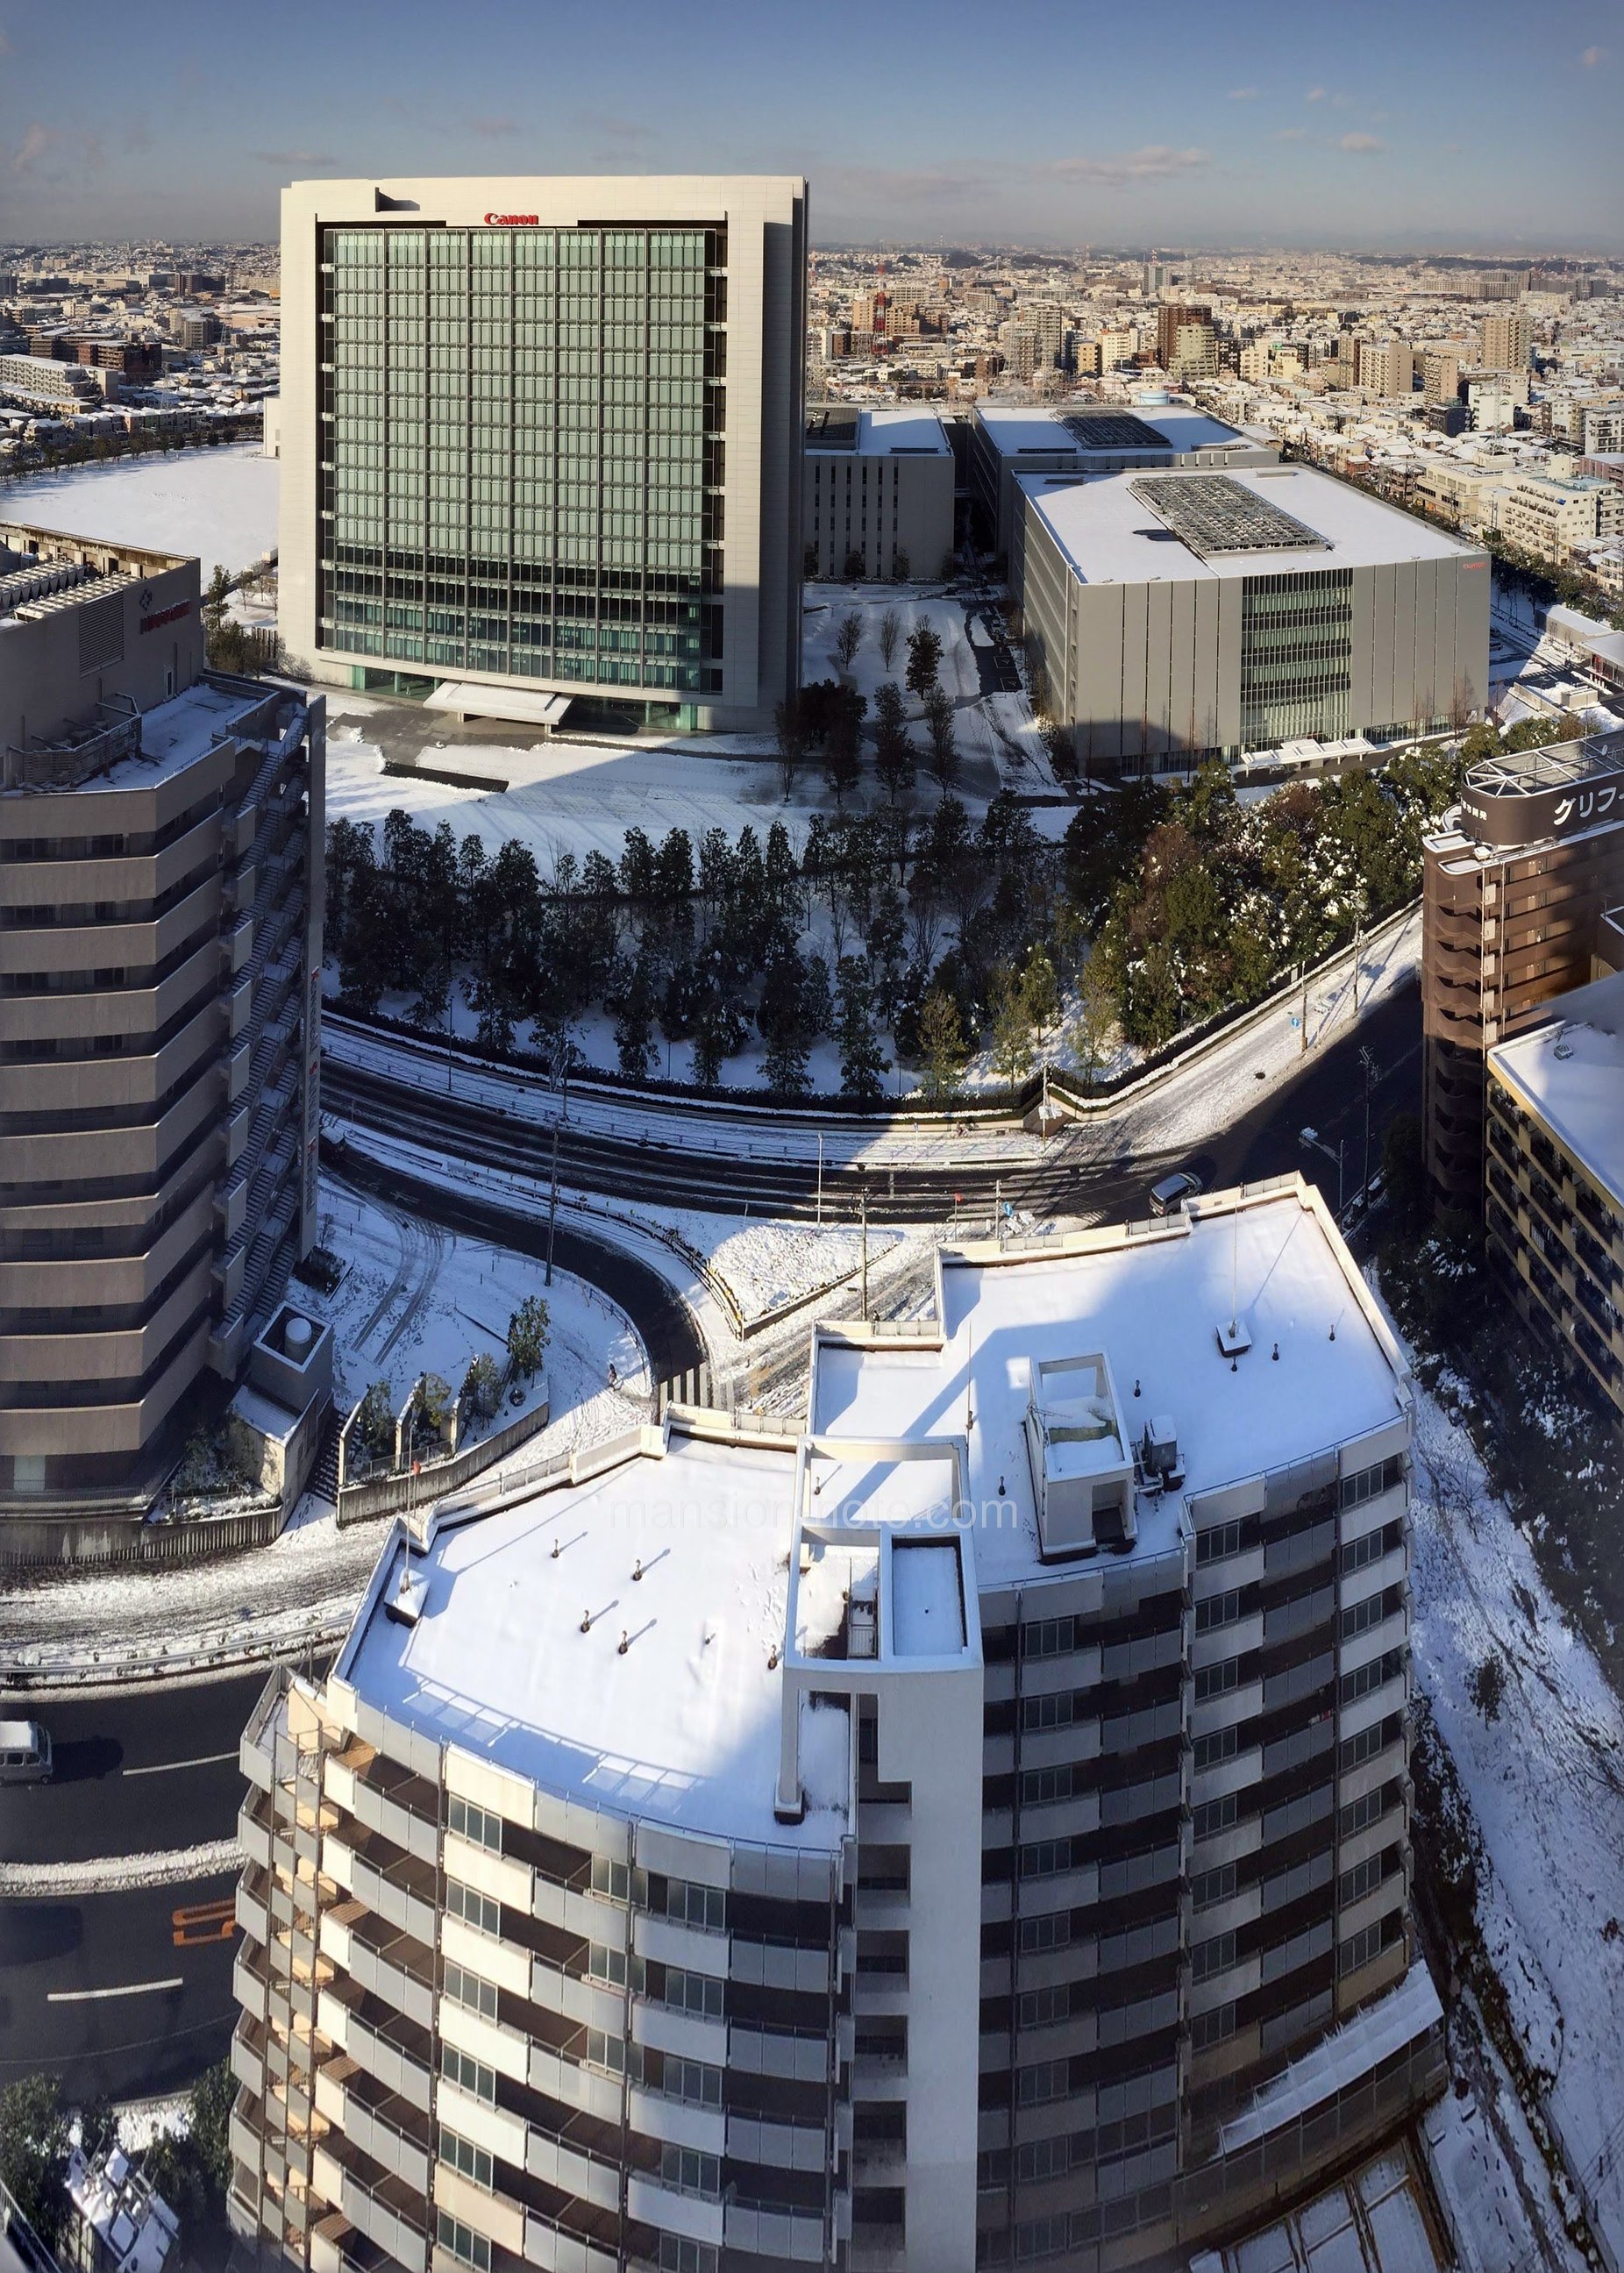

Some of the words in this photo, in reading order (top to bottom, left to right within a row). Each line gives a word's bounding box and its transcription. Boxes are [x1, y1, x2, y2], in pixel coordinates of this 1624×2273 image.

[484, 213, 538, 225] Canon
[1553, 787, 1624, 825] グリフ
